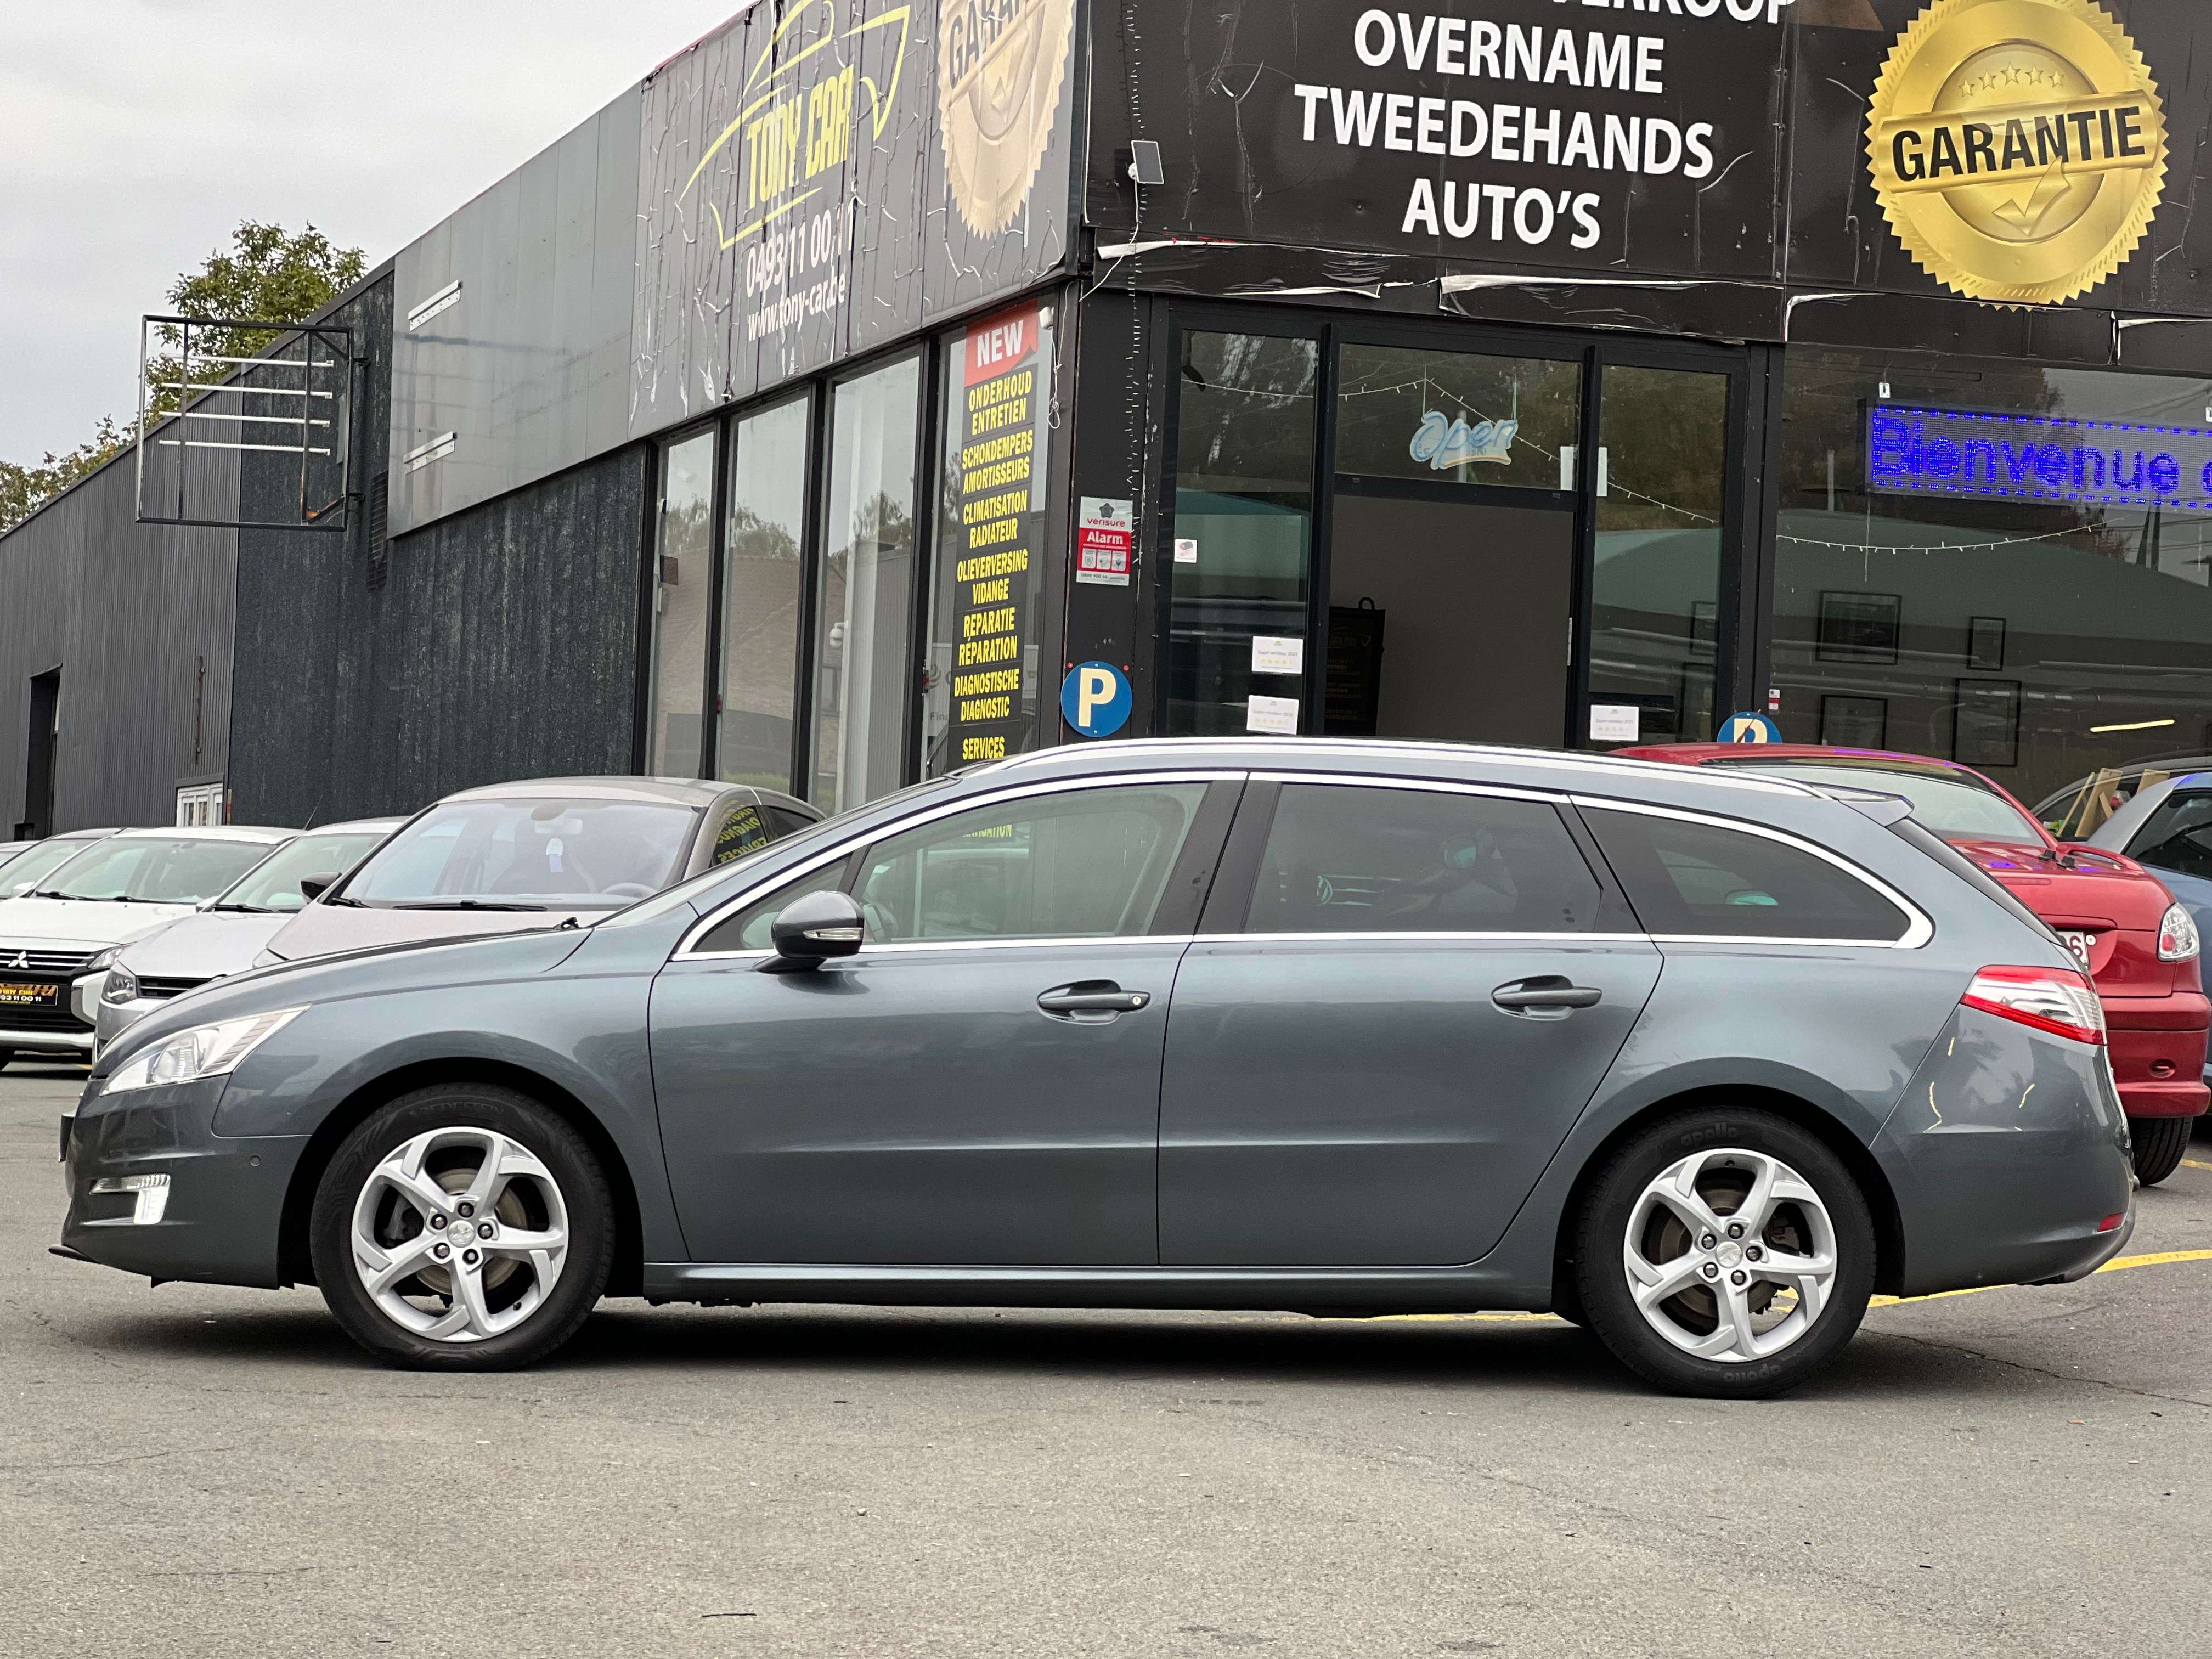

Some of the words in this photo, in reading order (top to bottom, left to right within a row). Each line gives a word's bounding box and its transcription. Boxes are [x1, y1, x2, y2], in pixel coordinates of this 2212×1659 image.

[1353, 9, 1664, 94] OVERNAME
[747, 93, 802, 210] TONY
[805, 64, 854, 180] CAR
[1294, 83, 1714, 179] TWEEDEHANDS
[1892, 106, 2146, 182] GARANTIE
[1402, 178, 1601, 249] AUTO'S
[748, 264, 846, 342] www.tony-car.be
[977, 320, 1024, 368] NEW
[969, 370, 1032, 411] ONDERHOUD
[972, 398, 1026, 436] ENTRETIEN
[962, 429, 1033, 470] SCHOKDEMPERS
[1871, 413, 2181, 494] Bienvenue
[963, 456, 1030, 494] AMORTISSEURS
[963, 490, 1028, 525] CLIMATISATION
[1087, 518, 1125, 527] verisure
[969, 518, 1018, 549] RADIATEUR
[1087, 531, 1124, 545] Alarm
[957, 549, 1028, 582] OLIEVERVERSING
[973, 578, 1009, 605] VIDANGE
[963, 607, 1015, 638] REPARATIE
[958, 636, 1018, 667] RÉPARATION
[955, 668, 1020, 697] DIAGNOSTISCHE
[1078, 668, 1116, 727] P
[960, 696, 1010, 721] DIAGNOSTIC
[962, 736, 1005, 760] SERVICES
